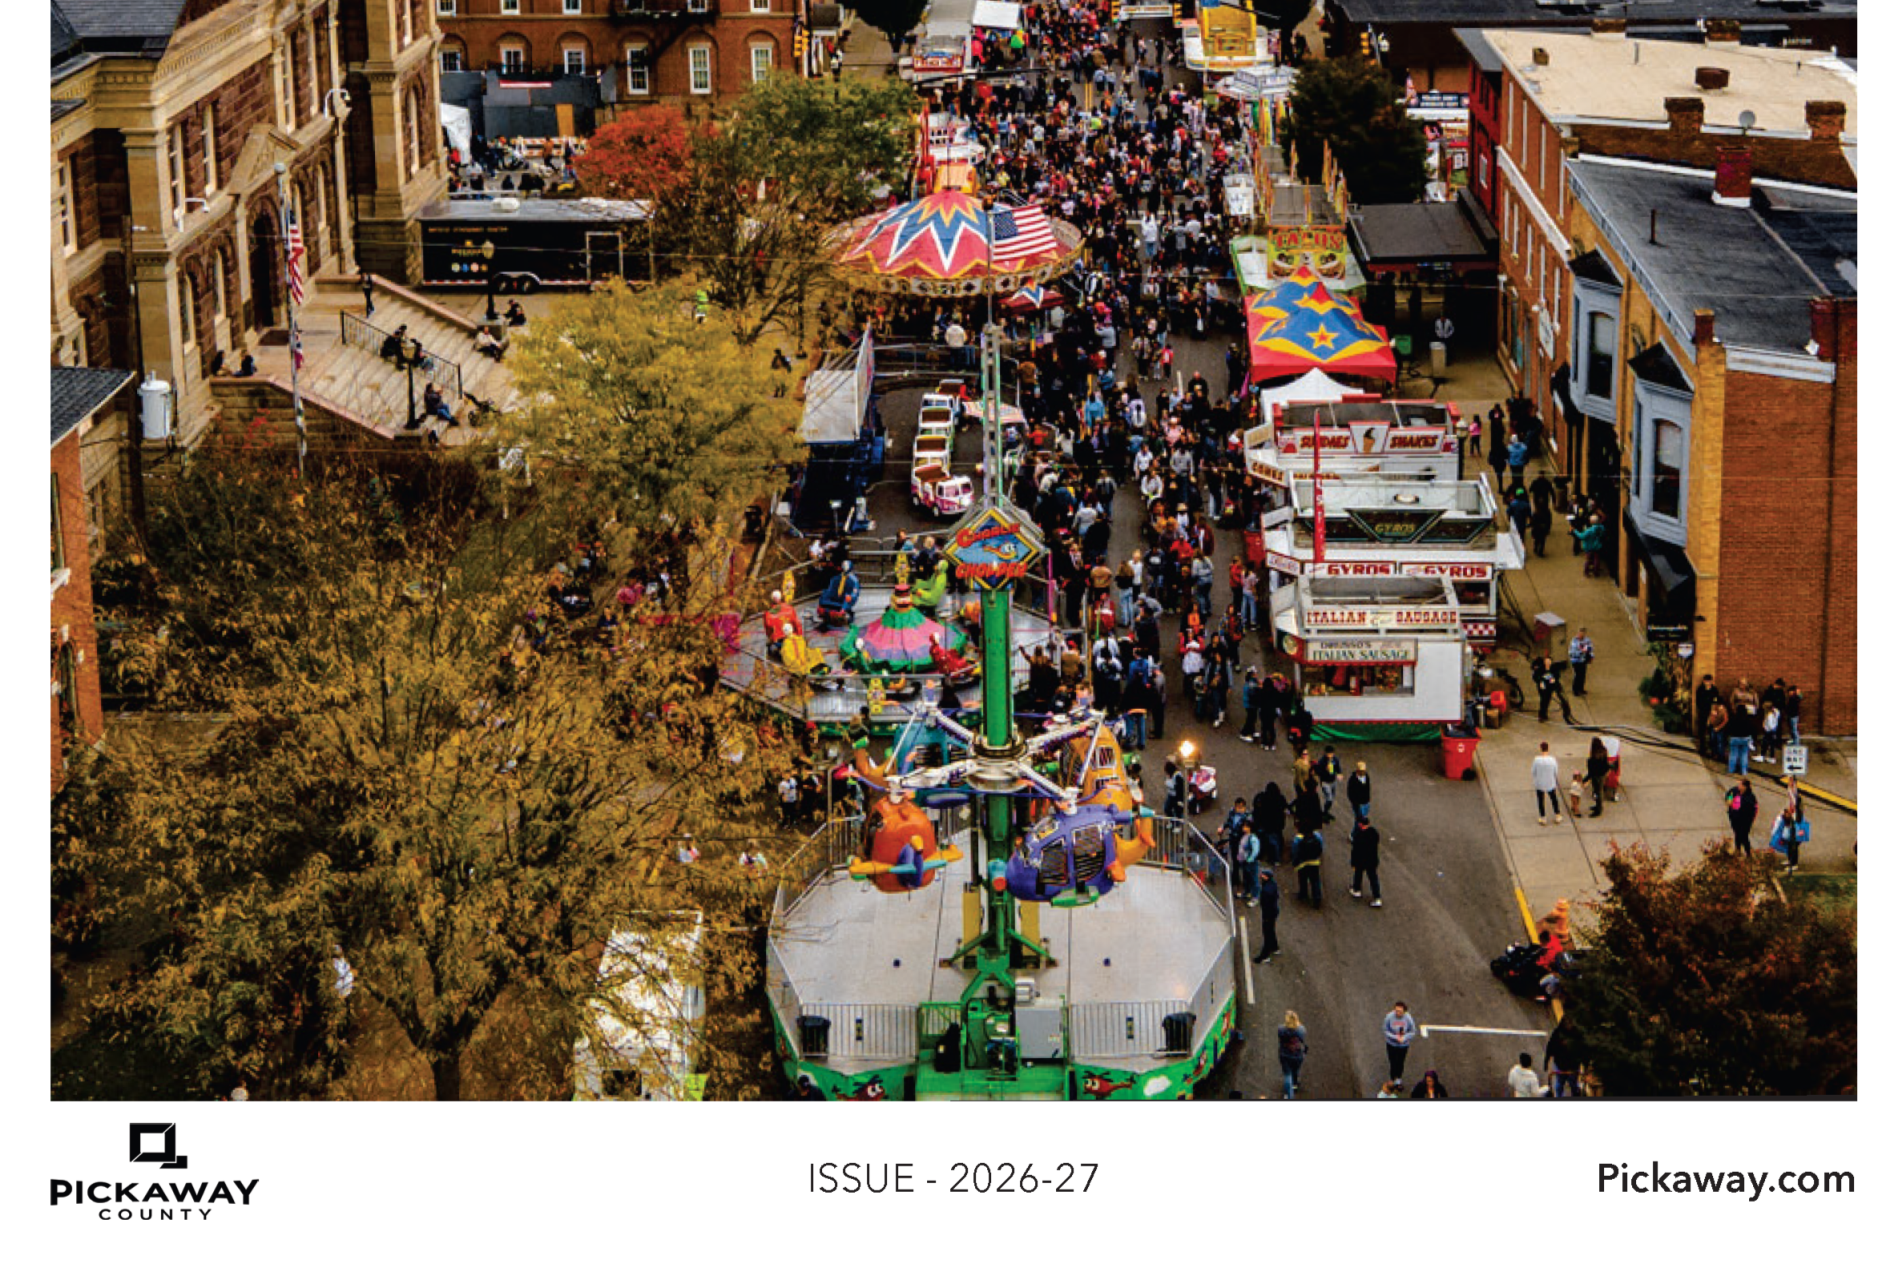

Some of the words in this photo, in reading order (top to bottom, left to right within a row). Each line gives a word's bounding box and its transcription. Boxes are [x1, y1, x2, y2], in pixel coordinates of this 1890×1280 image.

[1327, 563, 1391, 575] GYROS
[1424, 565, 1488, 578] GYROS
[1306, 611, 1366, 624] ITALIAN
[1396, 611, 1457, 624] SAUSAGE
